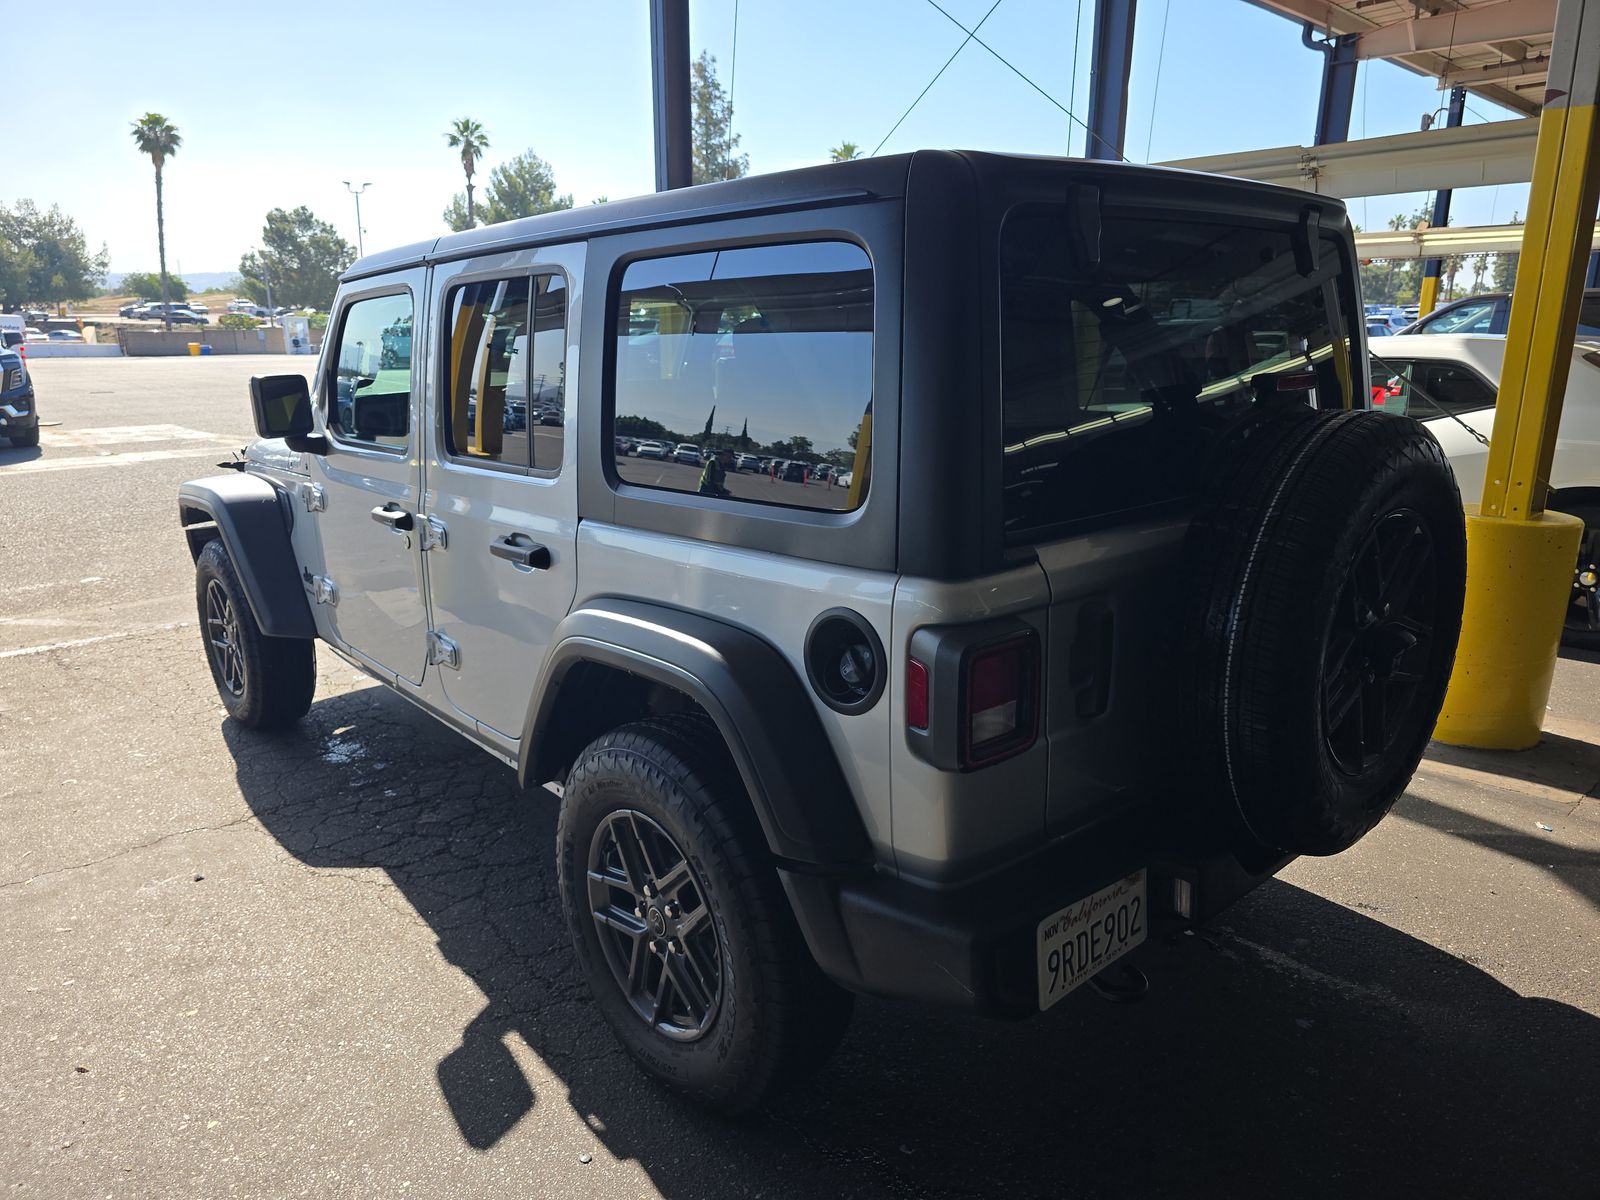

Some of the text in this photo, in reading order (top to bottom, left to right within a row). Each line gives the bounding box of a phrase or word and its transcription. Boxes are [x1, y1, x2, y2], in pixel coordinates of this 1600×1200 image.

[1044, 922, 1059, 941] NOV
[1060, 886, 1129, 933] California
[1048, 896, 1141, 994] 9RDE902
